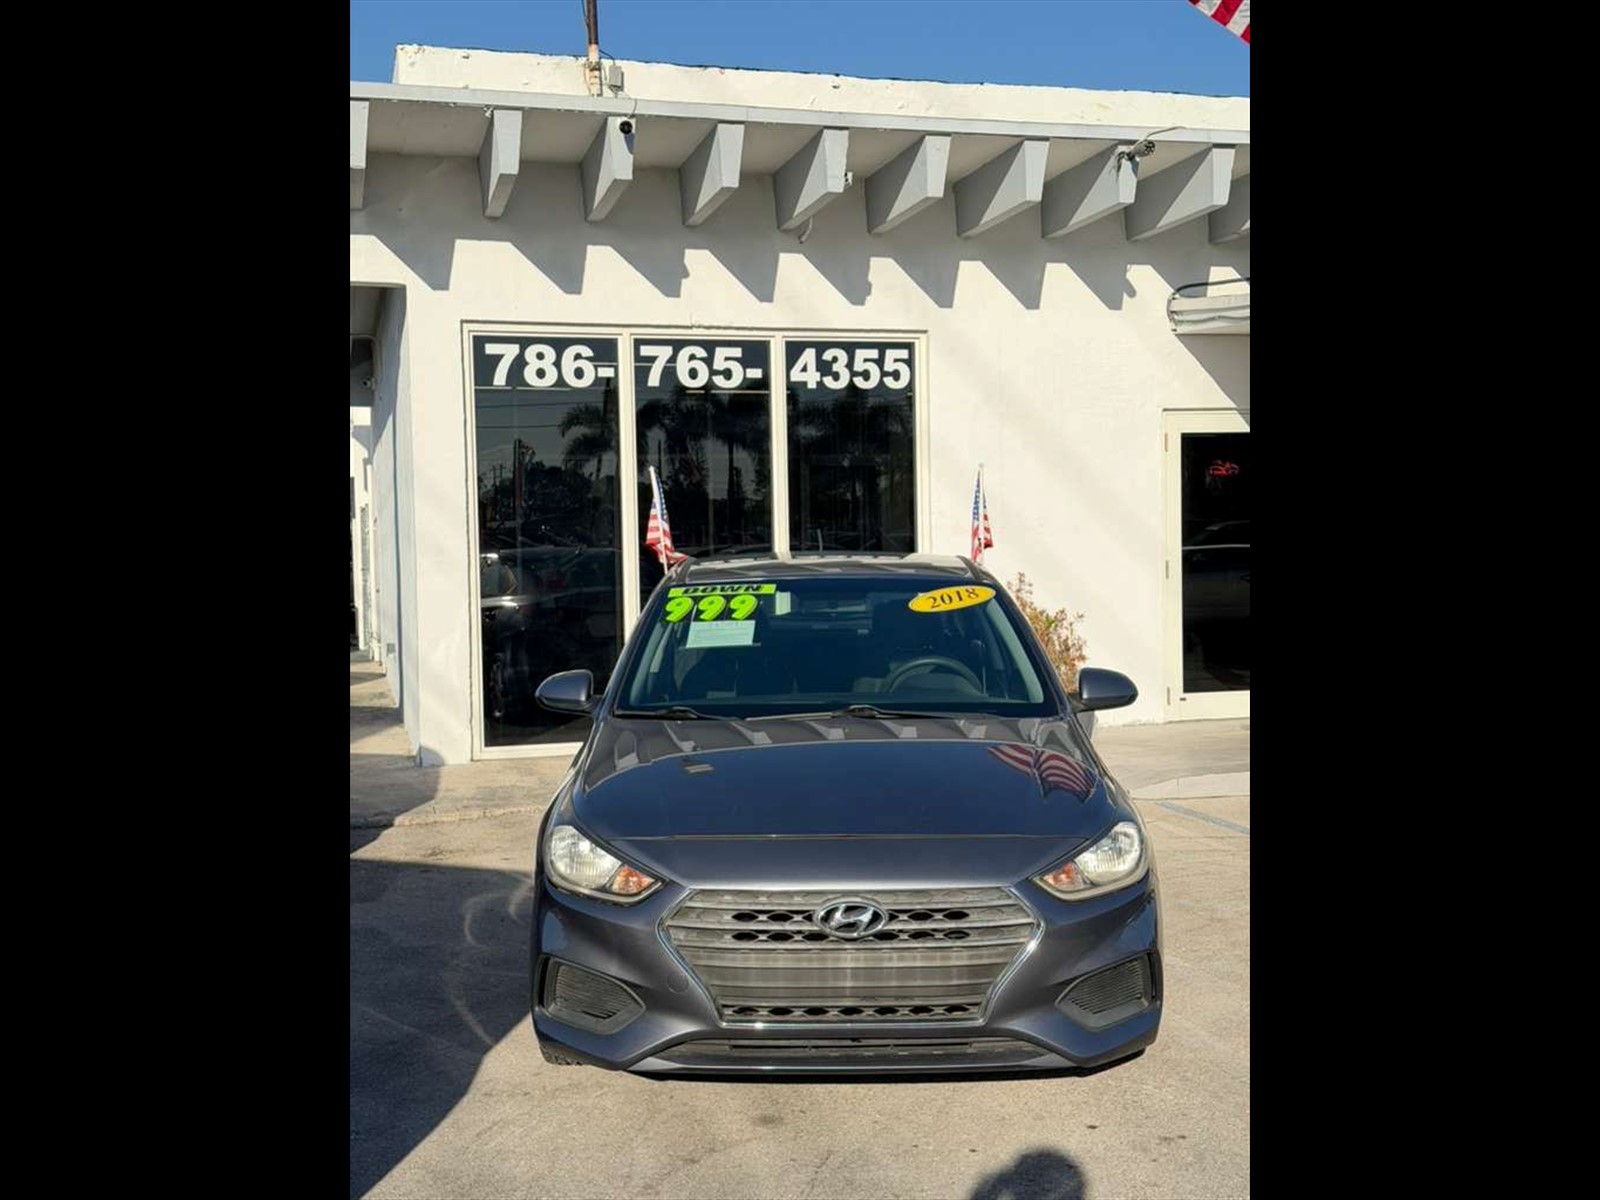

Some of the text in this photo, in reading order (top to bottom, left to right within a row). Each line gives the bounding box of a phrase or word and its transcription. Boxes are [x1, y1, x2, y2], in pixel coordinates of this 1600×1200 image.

[484, 343, 911, 390] 786- 765- 4355
[682, 585, 762, 595] DOWN
[926, 587, 979, 609] 2018
[665, 594, 759, 622] 999
